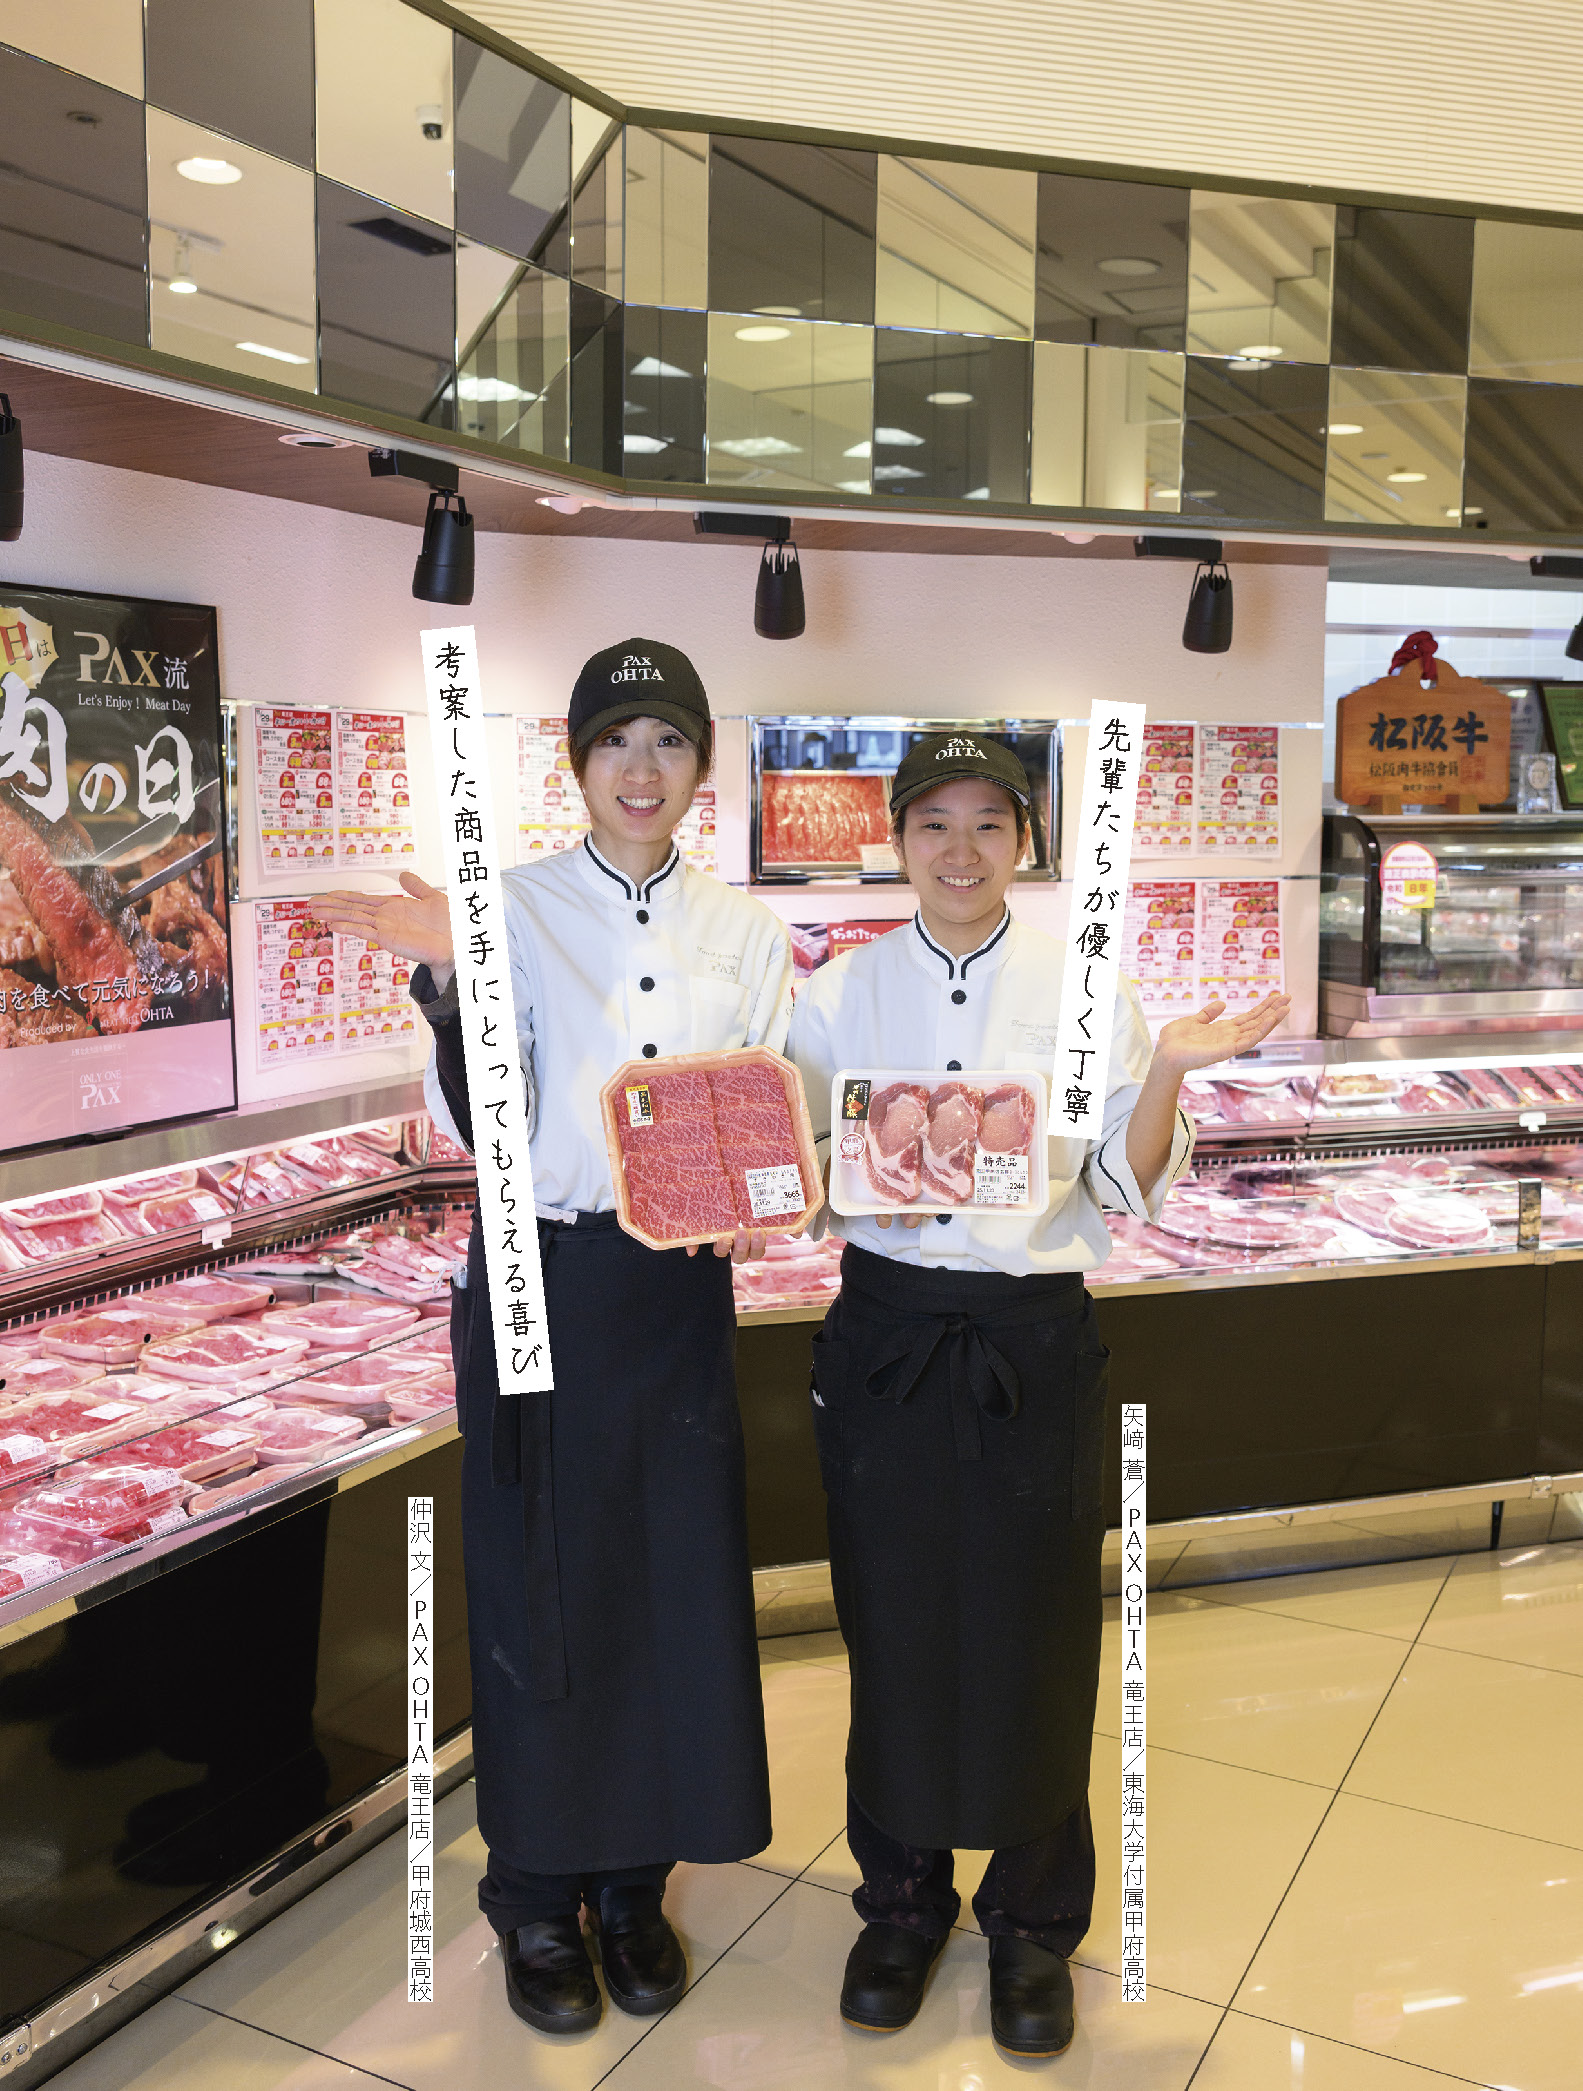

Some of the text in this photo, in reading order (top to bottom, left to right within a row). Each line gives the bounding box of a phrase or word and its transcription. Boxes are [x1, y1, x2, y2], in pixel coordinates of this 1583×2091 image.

[622, 655, 652, 668] PAX
[611, 668, 665, 684] OHTA
[78, 693, 103, 707] Let's
[105, 695, 133, 711] Enjoy
[145, 698, 170, 711] Meat
[172, 699, 191, 715] Day
[1369, 711, 1489, 755] 松阪牛
[947, 737, 976, 748] PAX
[935, 747, 988, 761] OHTA
[140, 1006, 175, 1023] OHTA
[80, 1072, 102, 1085] ONLY
[79, 1084, 121, 1110] PAX
[983, 1156, 1018, 1168] 特売品
[1009, 1182, 1026, 1190] 2244
